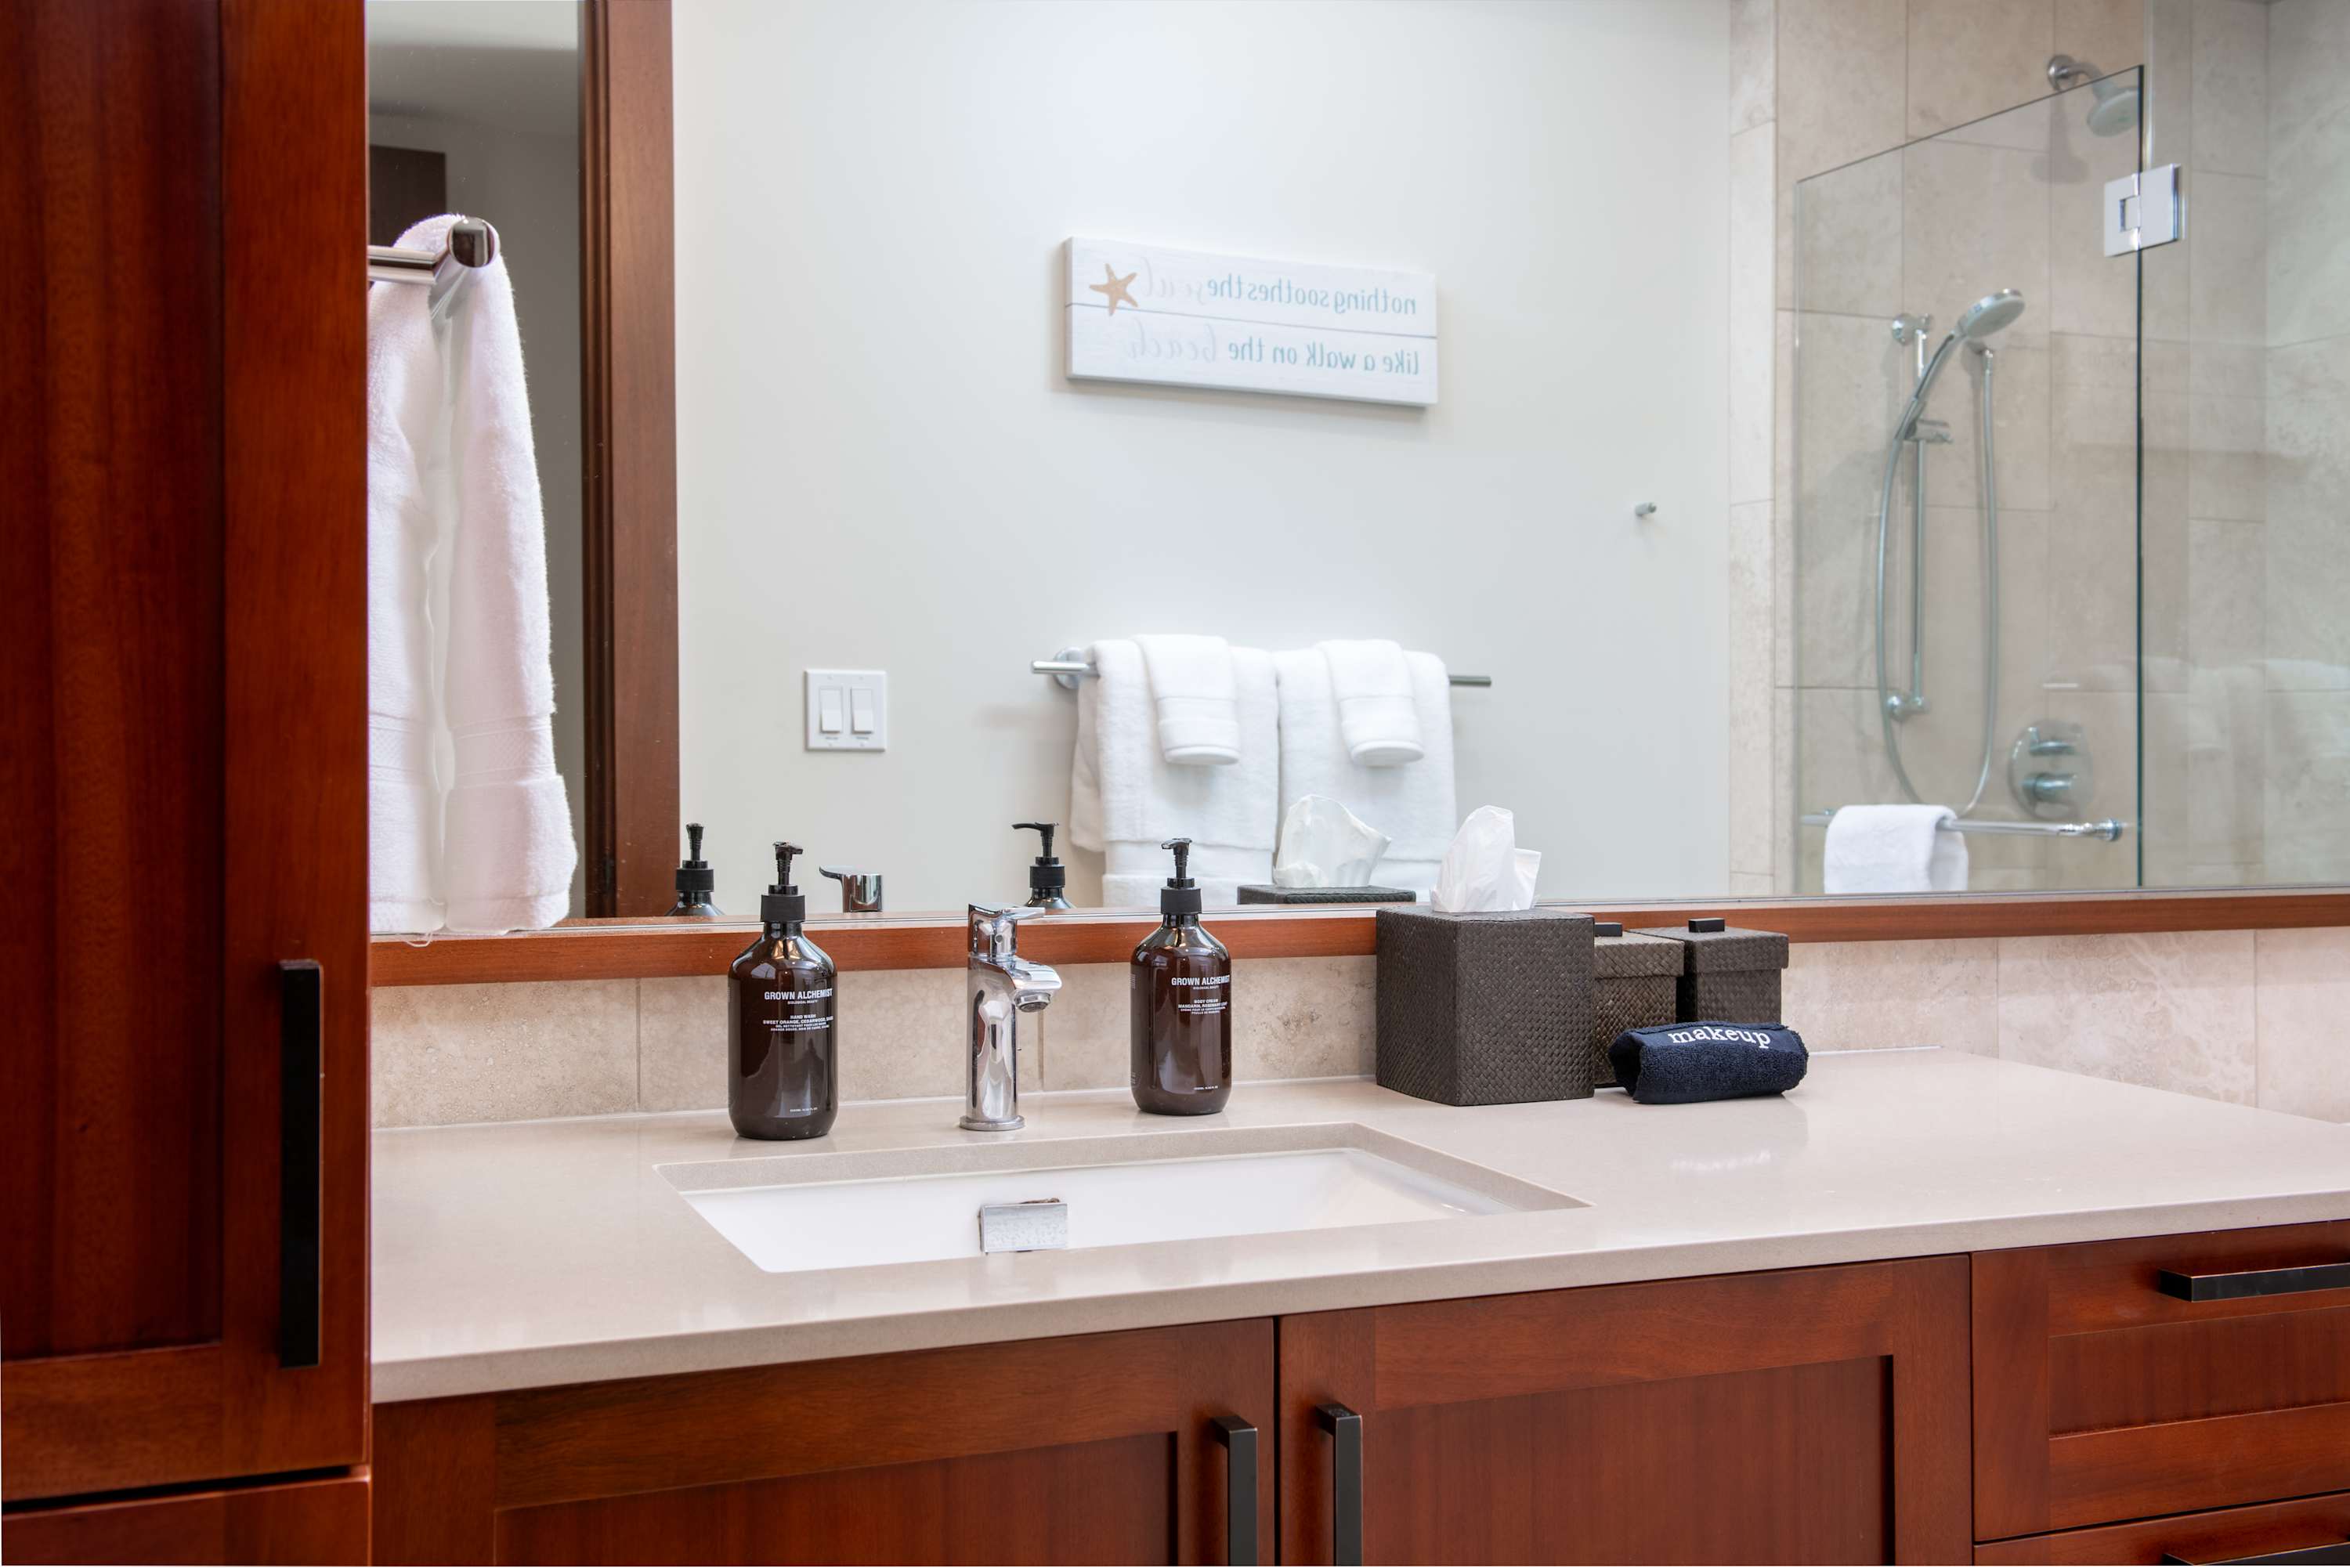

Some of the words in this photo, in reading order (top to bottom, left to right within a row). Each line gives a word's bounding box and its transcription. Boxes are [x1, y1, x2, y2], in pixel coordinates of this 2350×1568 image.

[1171, 977, 1200, 986] GROWN
[1201, 975, 1231, 985] ALCHEMIST
[765, 992, 795, 1000] GROWN
[797, 988, 833, 999] ALCHEMIST
[1668, 1026, 1771, 1050] makeup
